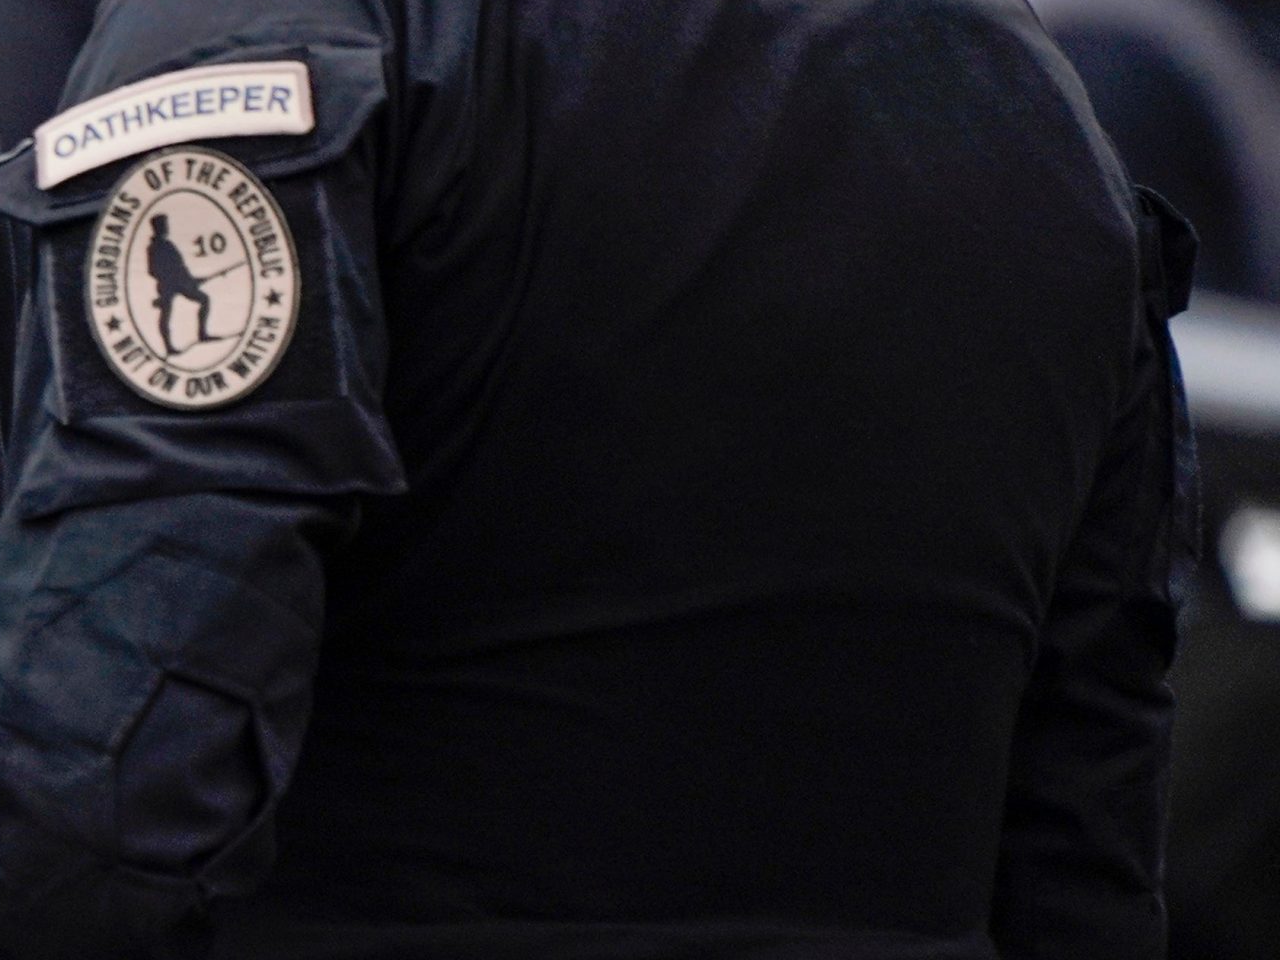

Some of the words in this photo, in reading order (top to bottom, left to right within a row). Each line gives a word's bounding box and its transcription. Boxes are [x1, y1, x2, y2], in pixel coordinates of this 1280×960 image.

[53, 84, 294, 158] OATHKEEPER
[95, 191, 142, 308] GUARDIANS
[143, 162, 174, 190] OF
[184, 158, 231, 190] THE
[228, 181, 284, 279] REPUBLIC
[192, 232, 227, 258] 10
[113, 336, 152, 373] NOT
[148, 369, 180, 391] ON
[185, 372, 228, 398] OUR
[227, 316, 280, 378] WATCH
